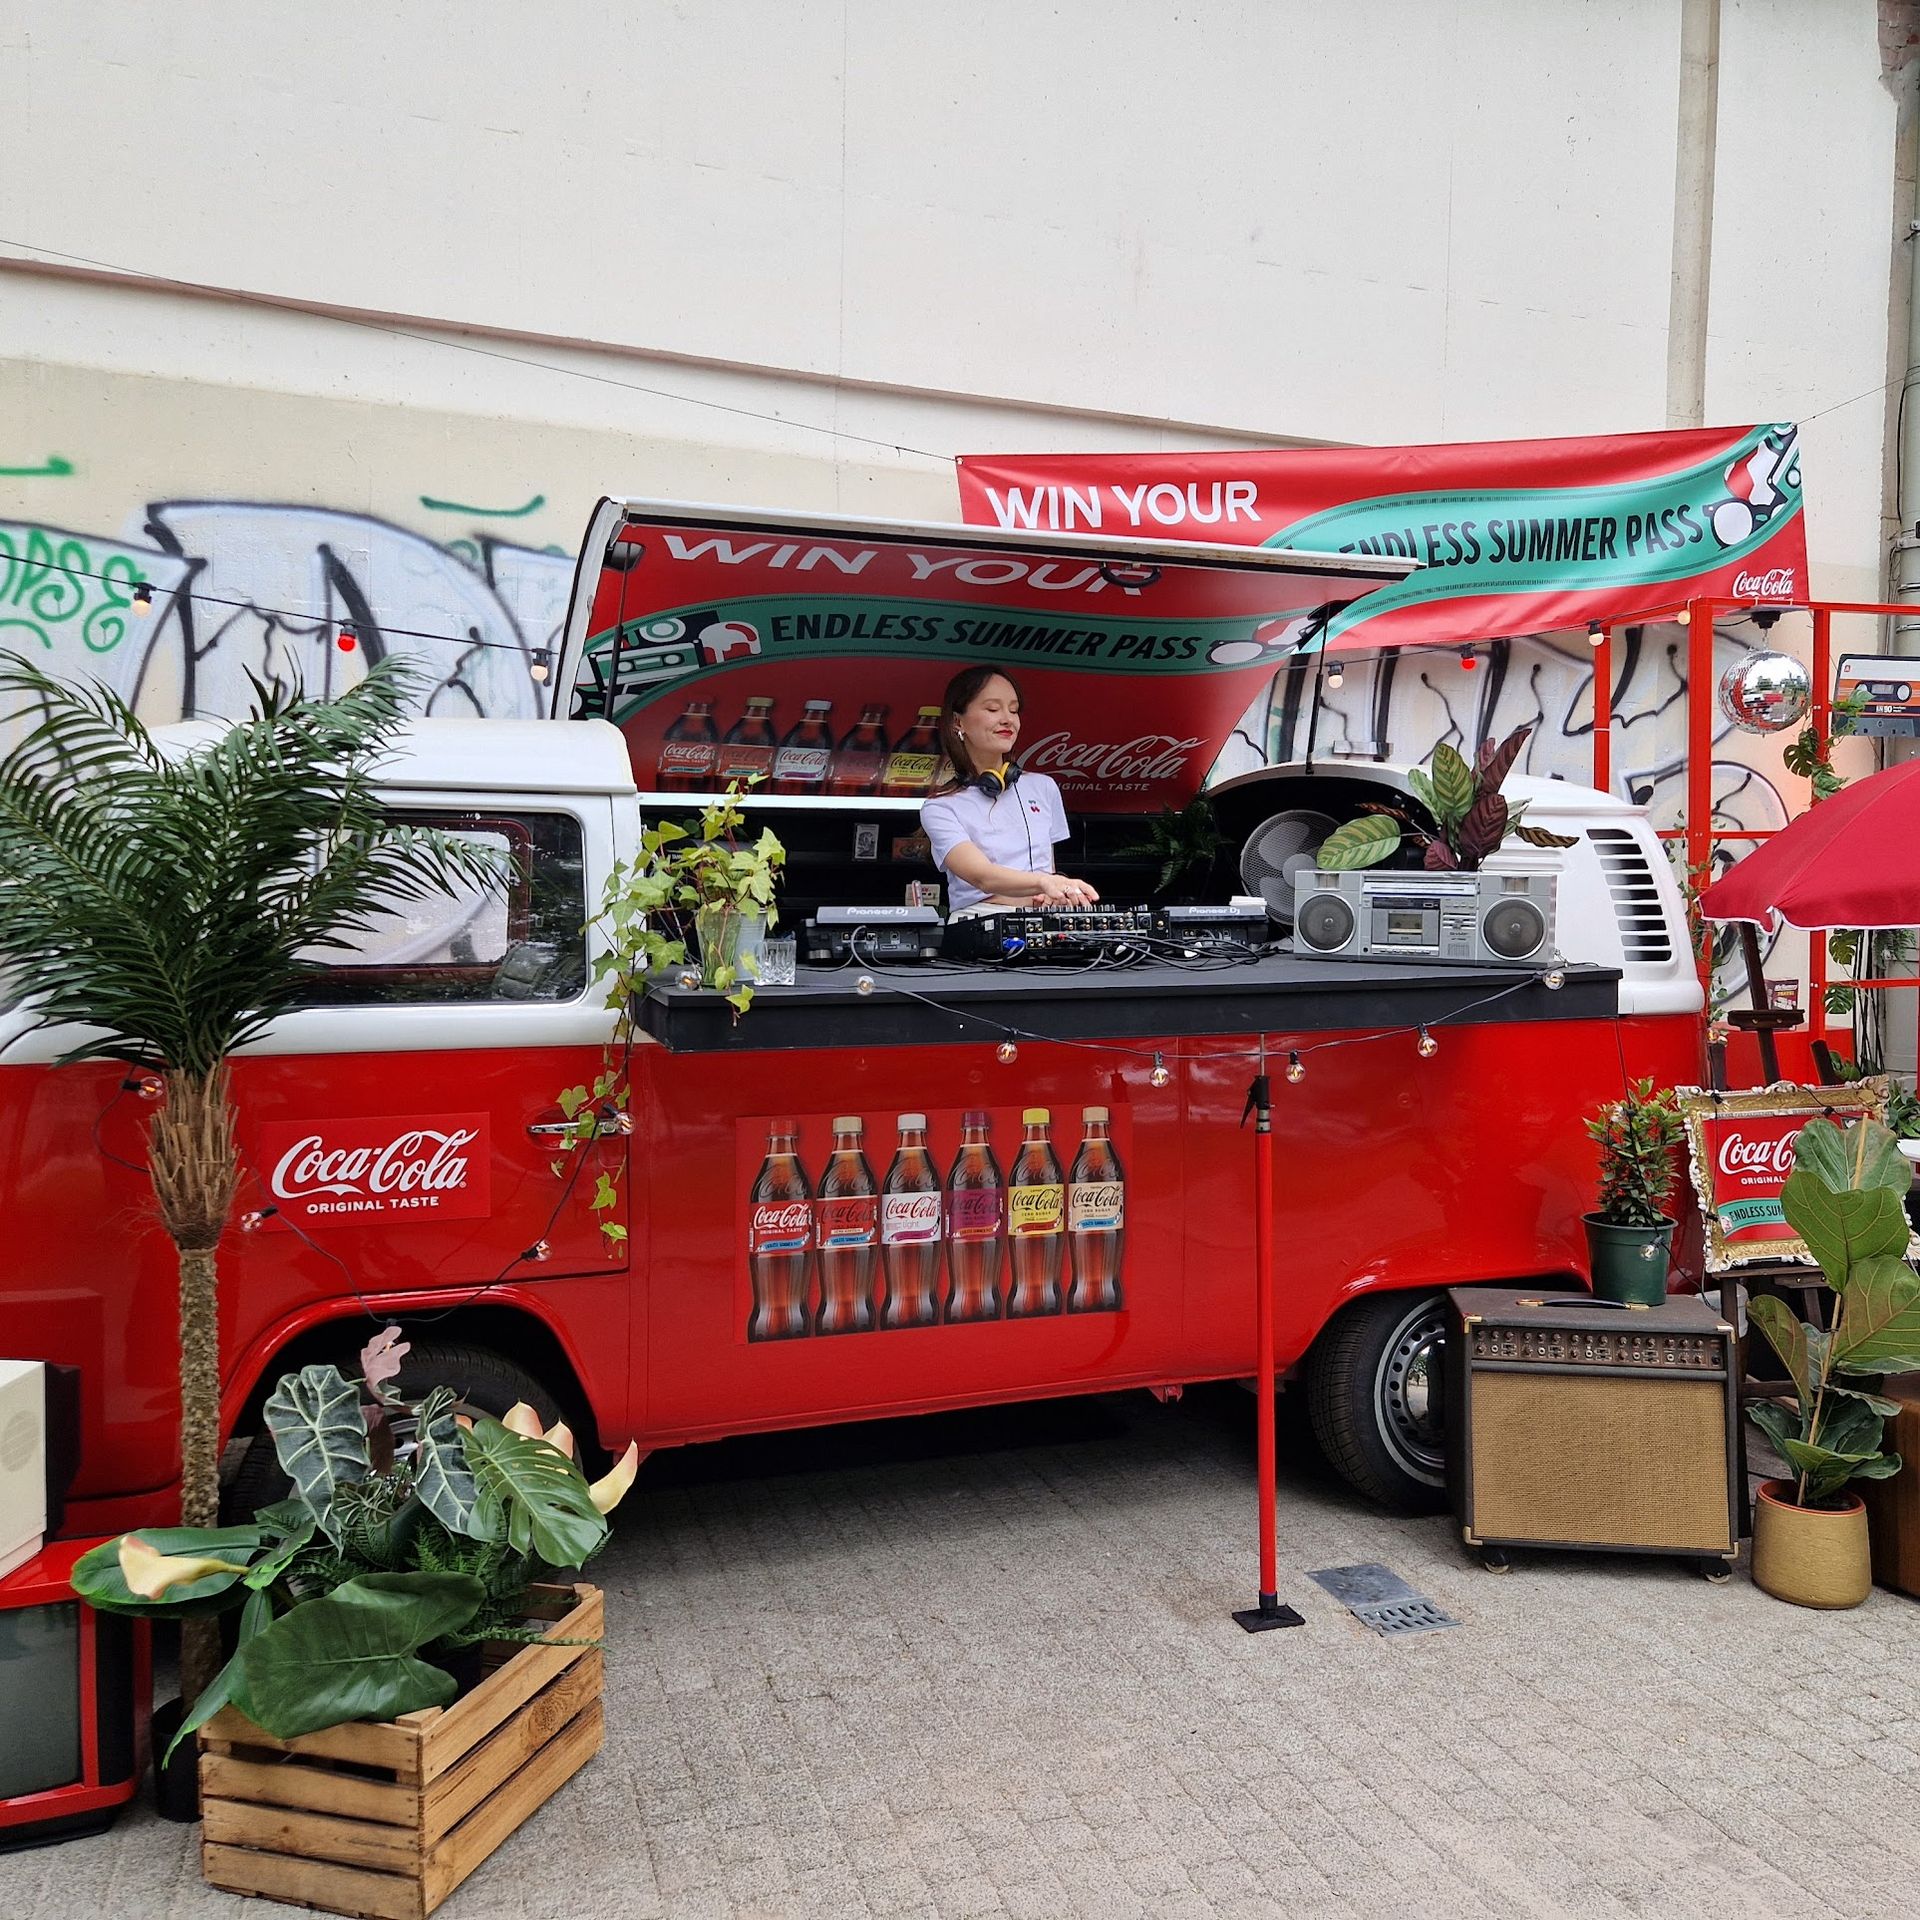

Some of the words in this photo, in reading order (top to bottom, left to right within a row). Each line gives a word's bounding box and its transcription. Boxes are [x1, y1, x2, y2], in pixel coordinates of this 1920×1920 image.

[986, 485, 1102, 530] WIN
[1111, 481, 1263, 526] YOUR
[1487, 516, 1618, 563] SUMMER
[1625, 504, 1704, 557] PASS
[662, 534, 879, 575] WIN
[1733, 567, 1796, 598] Coca-Cola
[771, 613, 944, 642] ENDLESS
[945, 618, 1116, 657] SUMMER
[1107, 634, 1203, 661] PASS
[664, 743, 713, 760] Coca-Cola
[1016, 731, 1211, 779] Coca-Cola
[1108, 782, 1151, 791] TASTE
[846, 906, 893, 915] Pioneer
[1188, 906, 1228, 915] Pioneer
[271, 1128, 480, 1199] Coca-Cola
[1741, 1176, 1786, 1185] ORIGINAL
[306, 1200, 385, 1215] ORIGINAL
[390, 1196, 440, 1210] TASTE
[886, 1195, 938, 1220] Coca-Cola
[1012, 1188, 1061, 1212] Coca-Cola
[1072, 1185, 1121, 1208] Coca-Cola
[754, 1203, 809, 1230] Coca-Cola
[1729, 1205, 1765, 1223] ENDLESS
